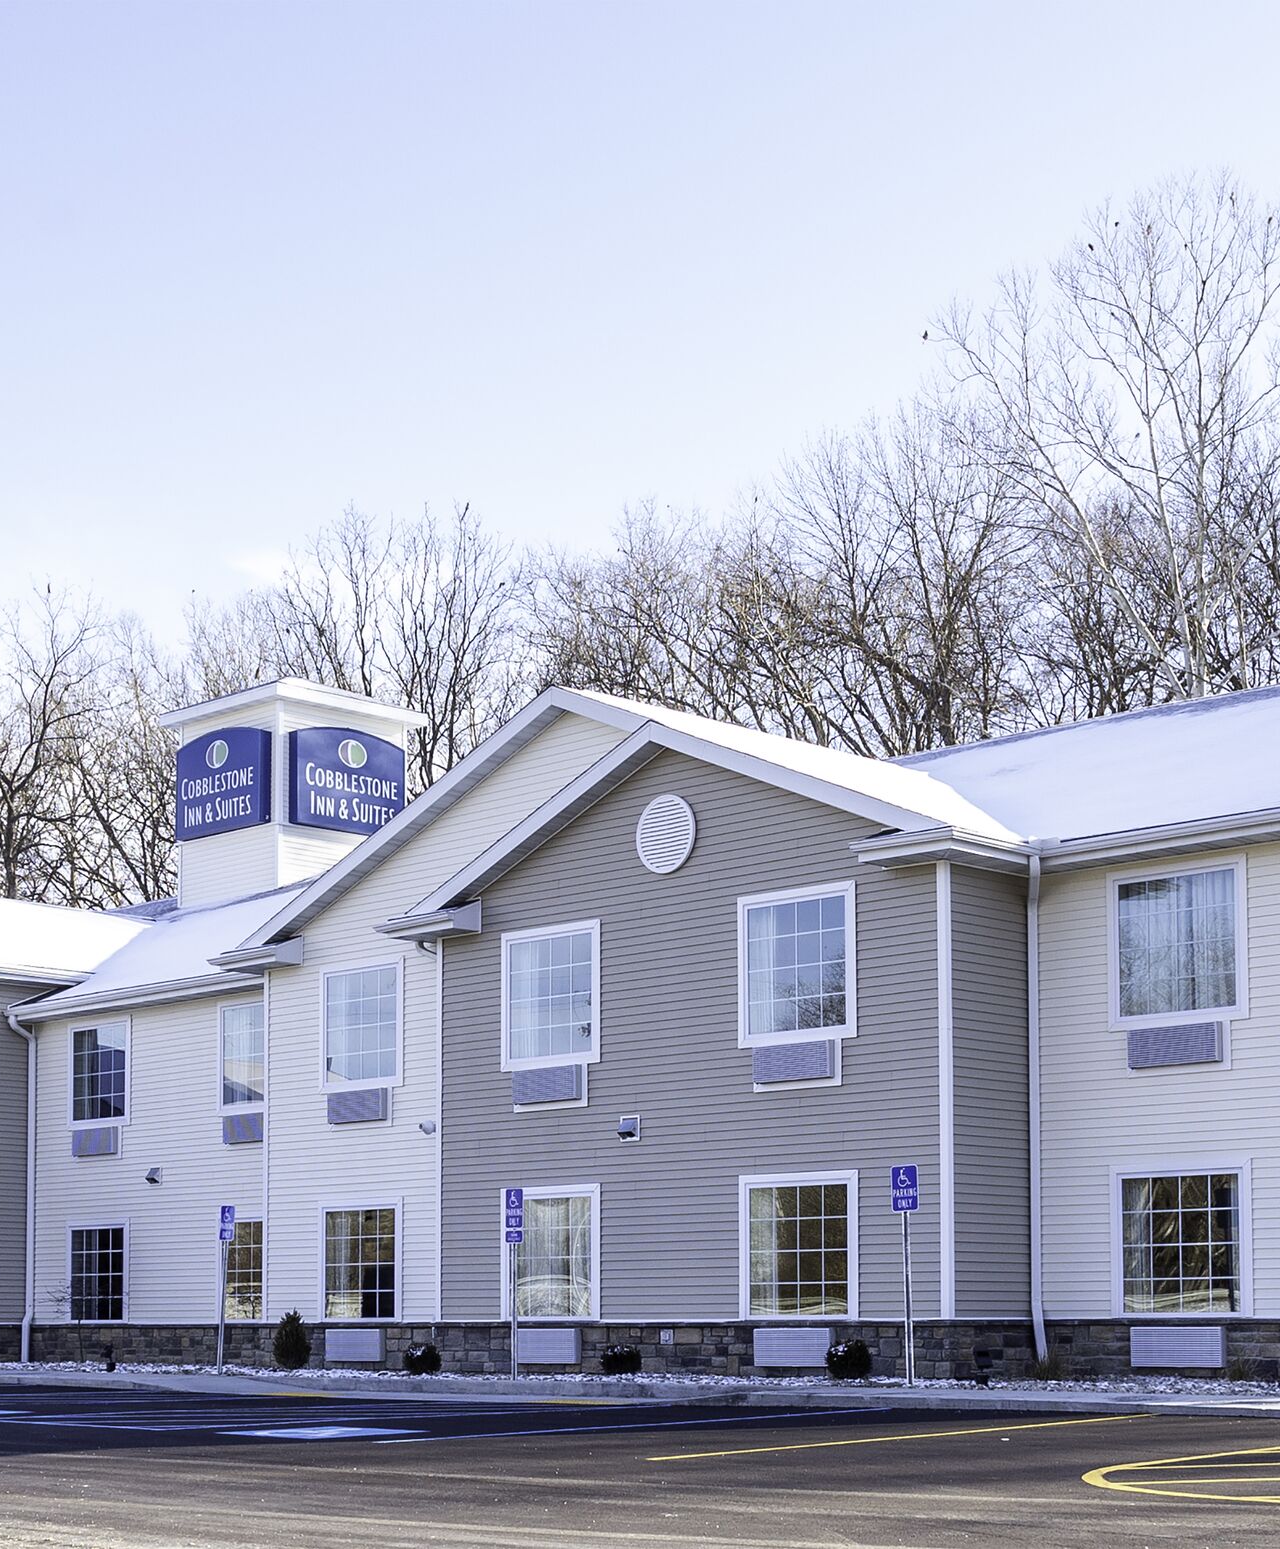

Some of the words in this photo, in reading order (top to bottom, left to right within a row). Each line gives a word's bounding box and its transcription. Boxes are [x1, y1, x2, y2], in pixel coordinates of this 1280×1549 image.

[181, 766, 254, 800] COBBLESTONE
[305, 762, 398, 800] COBBLESTONE
[184, 805, 202, 828] INN
[205, 802, 213, 823] &
[215, 794, 251, 821] SUITES
[310, 790, 335, 818] INN
[338, 798, 349, 820] &
[893, 1187, 917, 1198] PARKING
[897, 1198, 913, 1209] ONLY
